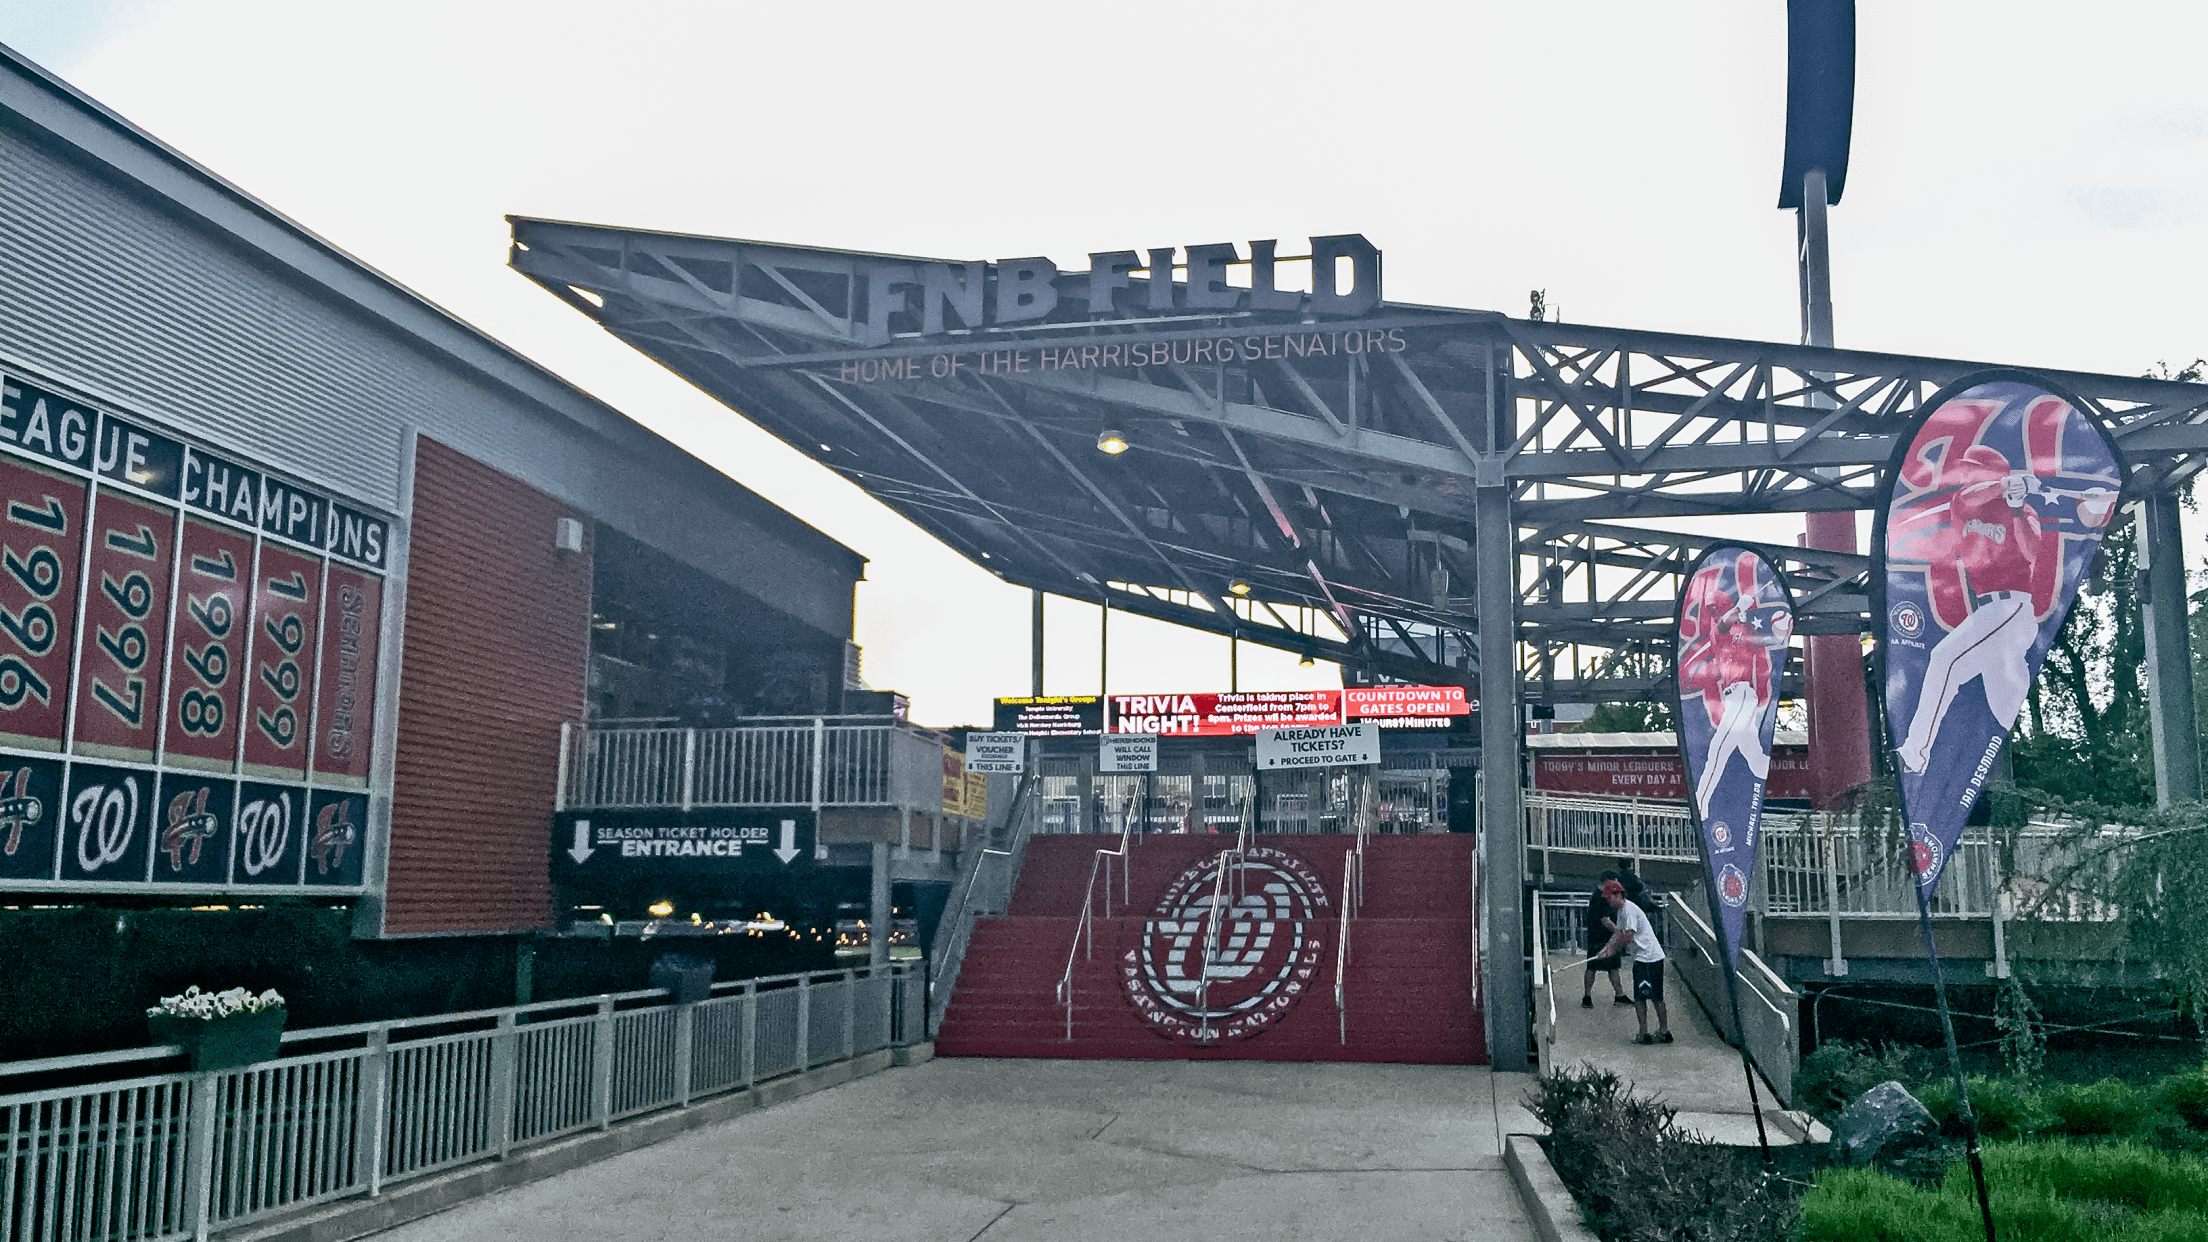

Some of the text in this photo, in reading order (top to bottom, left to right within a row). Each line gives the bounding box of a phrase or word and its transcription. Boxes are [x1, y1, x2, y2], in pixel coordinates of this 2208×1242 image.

[852, 233, 1382, 348] FNB FIELD
[840, 329, 1406, 384] HOME OF THE HARRISBURG SENATORS
[0, 385, 382, 563] EAGUE CHAMPIONS
[0, 494, 67, 711] 1996
[91, 523, 157, 729] 1997
[179, 549, 237, 738] 1998
[257, 571, 308, 749] 1999
[1217, 692, 1326, 702] Trivia is taking place in
[1348, 690, 1463, 702] COUNTDOWN TO
[1115, 695, 1198, 714] TRIVIA
[1215, 703, 1268, 712] Centerfield
[1269, 703, 1293, 711] from
[1295, 702, 1316, 712] 7pm
[1360, 703, 1450, 714] GATES OPEN!
[1118, 715, 1200, 733] NIGHT!
[1208, 712, 1337, 723] 8pm. Prizes will be awarded
[1231, 724, 1242, 732] to
[1243, 724, 1260, 732] the
[1274, 727, 1361, 741] ALREADY HAVE
[1291, 740, 1345, 752] TICKETS?
[1281, 754, 1357, 765] PROCEED TO GATE
[1587, 761, 1620, 771] MINOR
[1623, 761, 1674, 771] LEAGUERS
[995, 763, 1013, 771] LINE
[1959, 735, 2003, 809] IAN DESMOND
[1612, 774, 1681, 784] EVERY DAY AT
[1745, 782, 1762, 847] MICHAEL TAYLOR
[597, 827, 769, 838] SEASON TICKET HOLDER
[622, 840, 742, 856] ENTRANCE
